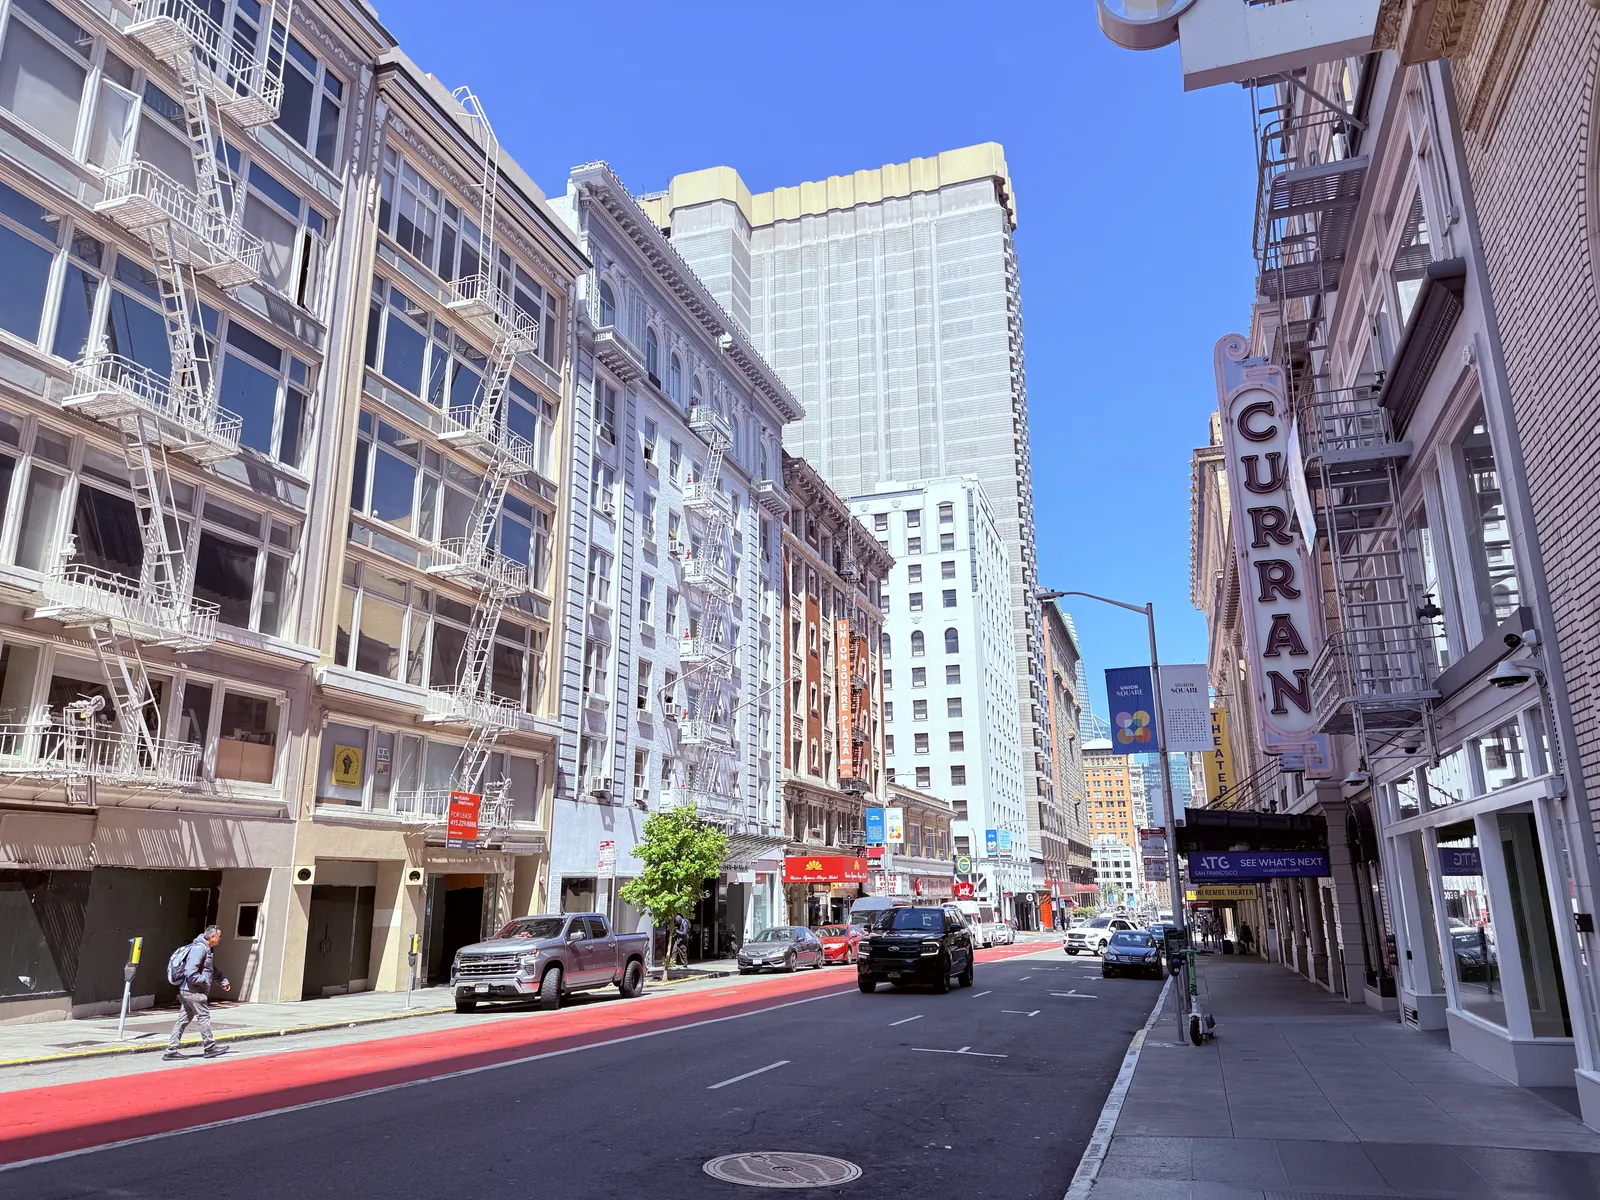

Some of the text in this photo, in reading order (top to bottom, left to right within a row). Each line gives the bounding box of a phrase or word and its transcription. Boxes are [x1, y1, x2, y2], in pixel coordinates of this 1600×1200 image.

[1237, 401, 1312, 715] CURRAN
[839, 623, 848, 661] UNION
[840, 664, 849, 711] SQUARE
[841, 717, 850, 755] PLAZA
[1210, 712, 1229, 796] THEATER
[1200, 856, 1323, 869] ATG SEE WHAT'S NEXT
[1025, 893, 1034, 901] G
